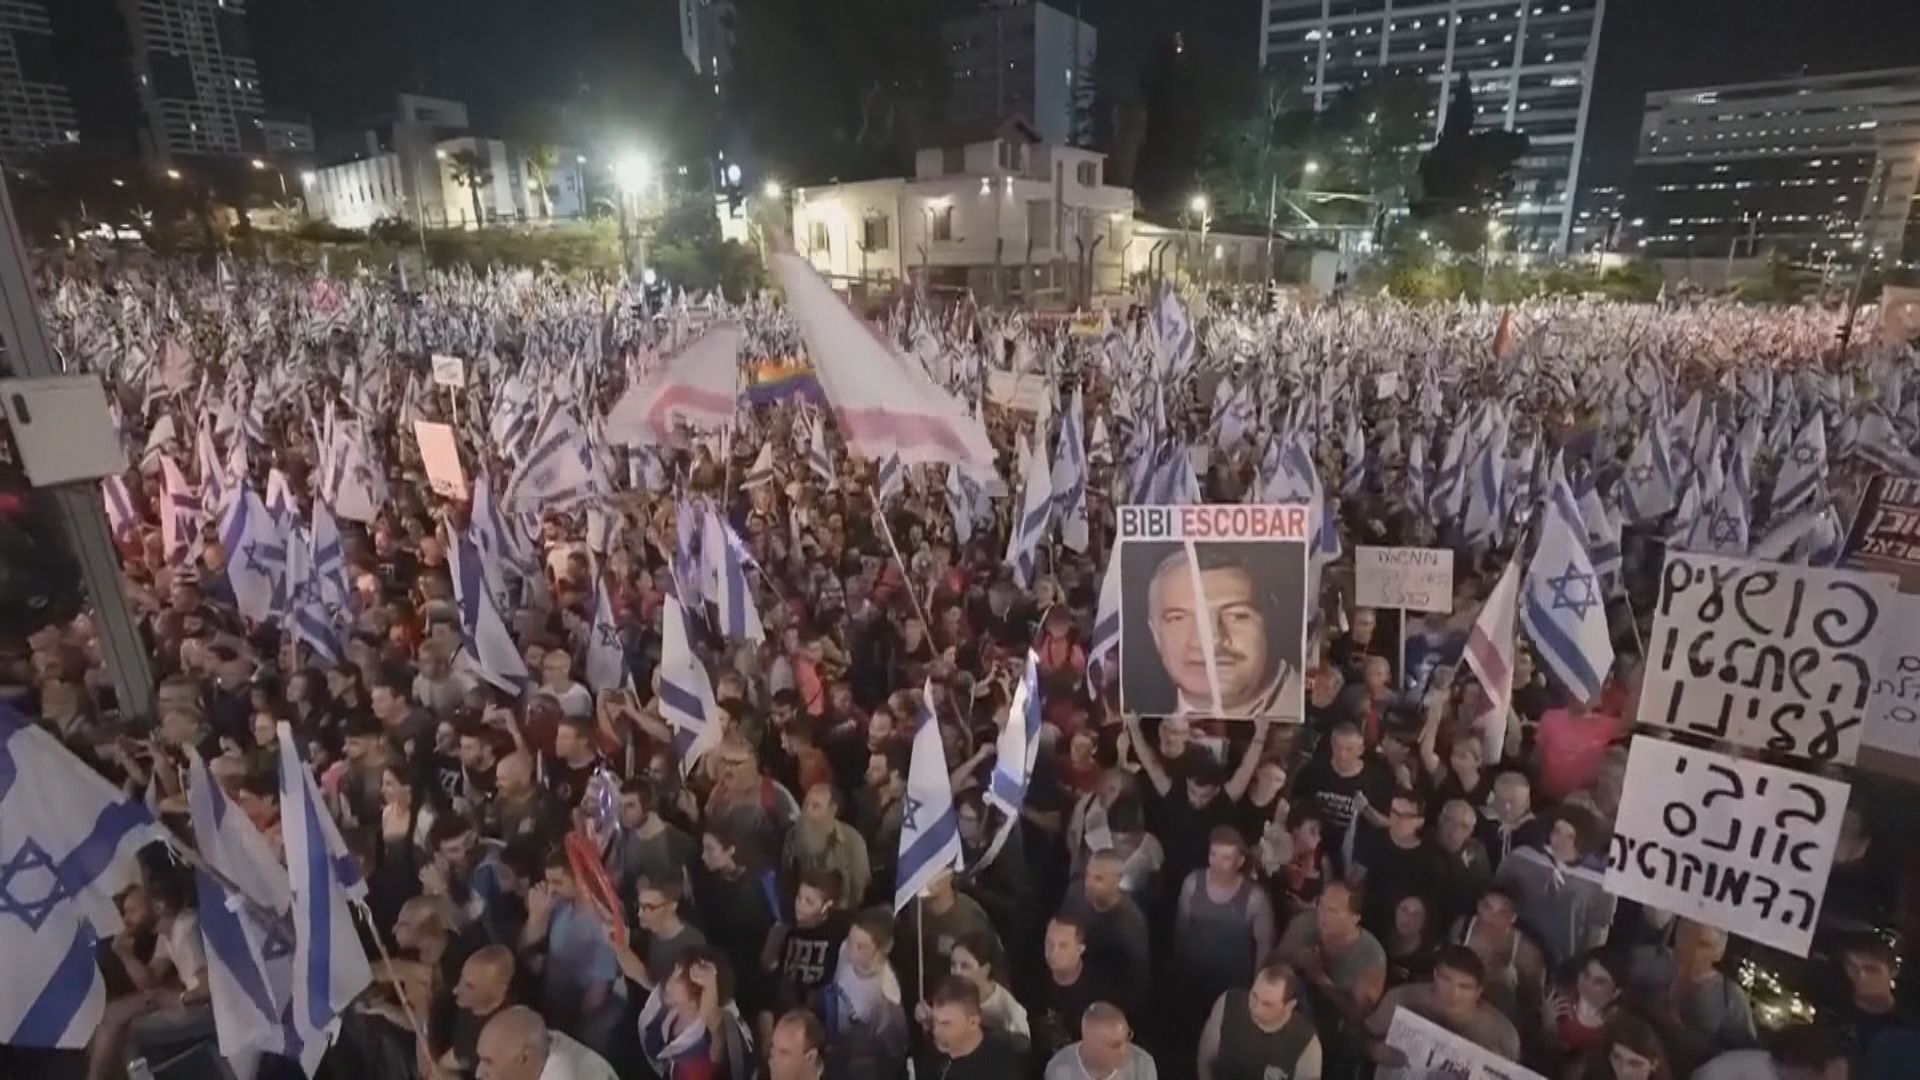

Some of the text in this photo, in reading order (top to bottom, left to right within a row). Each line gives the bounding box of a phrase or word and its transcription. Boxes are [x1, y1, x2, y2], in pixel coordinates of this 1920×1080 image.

[1122, 508, 1305, 537] BIBI ESCOBAR
[1662, 558, 1879, 648] פושעים
[1662, 627, 1871, 709] השתלטו
[1666, 680, 1861, 760] עלינו
[1675, 757, 1826, 829] ביבי
[1663, 801, 1819, 872] אונס
